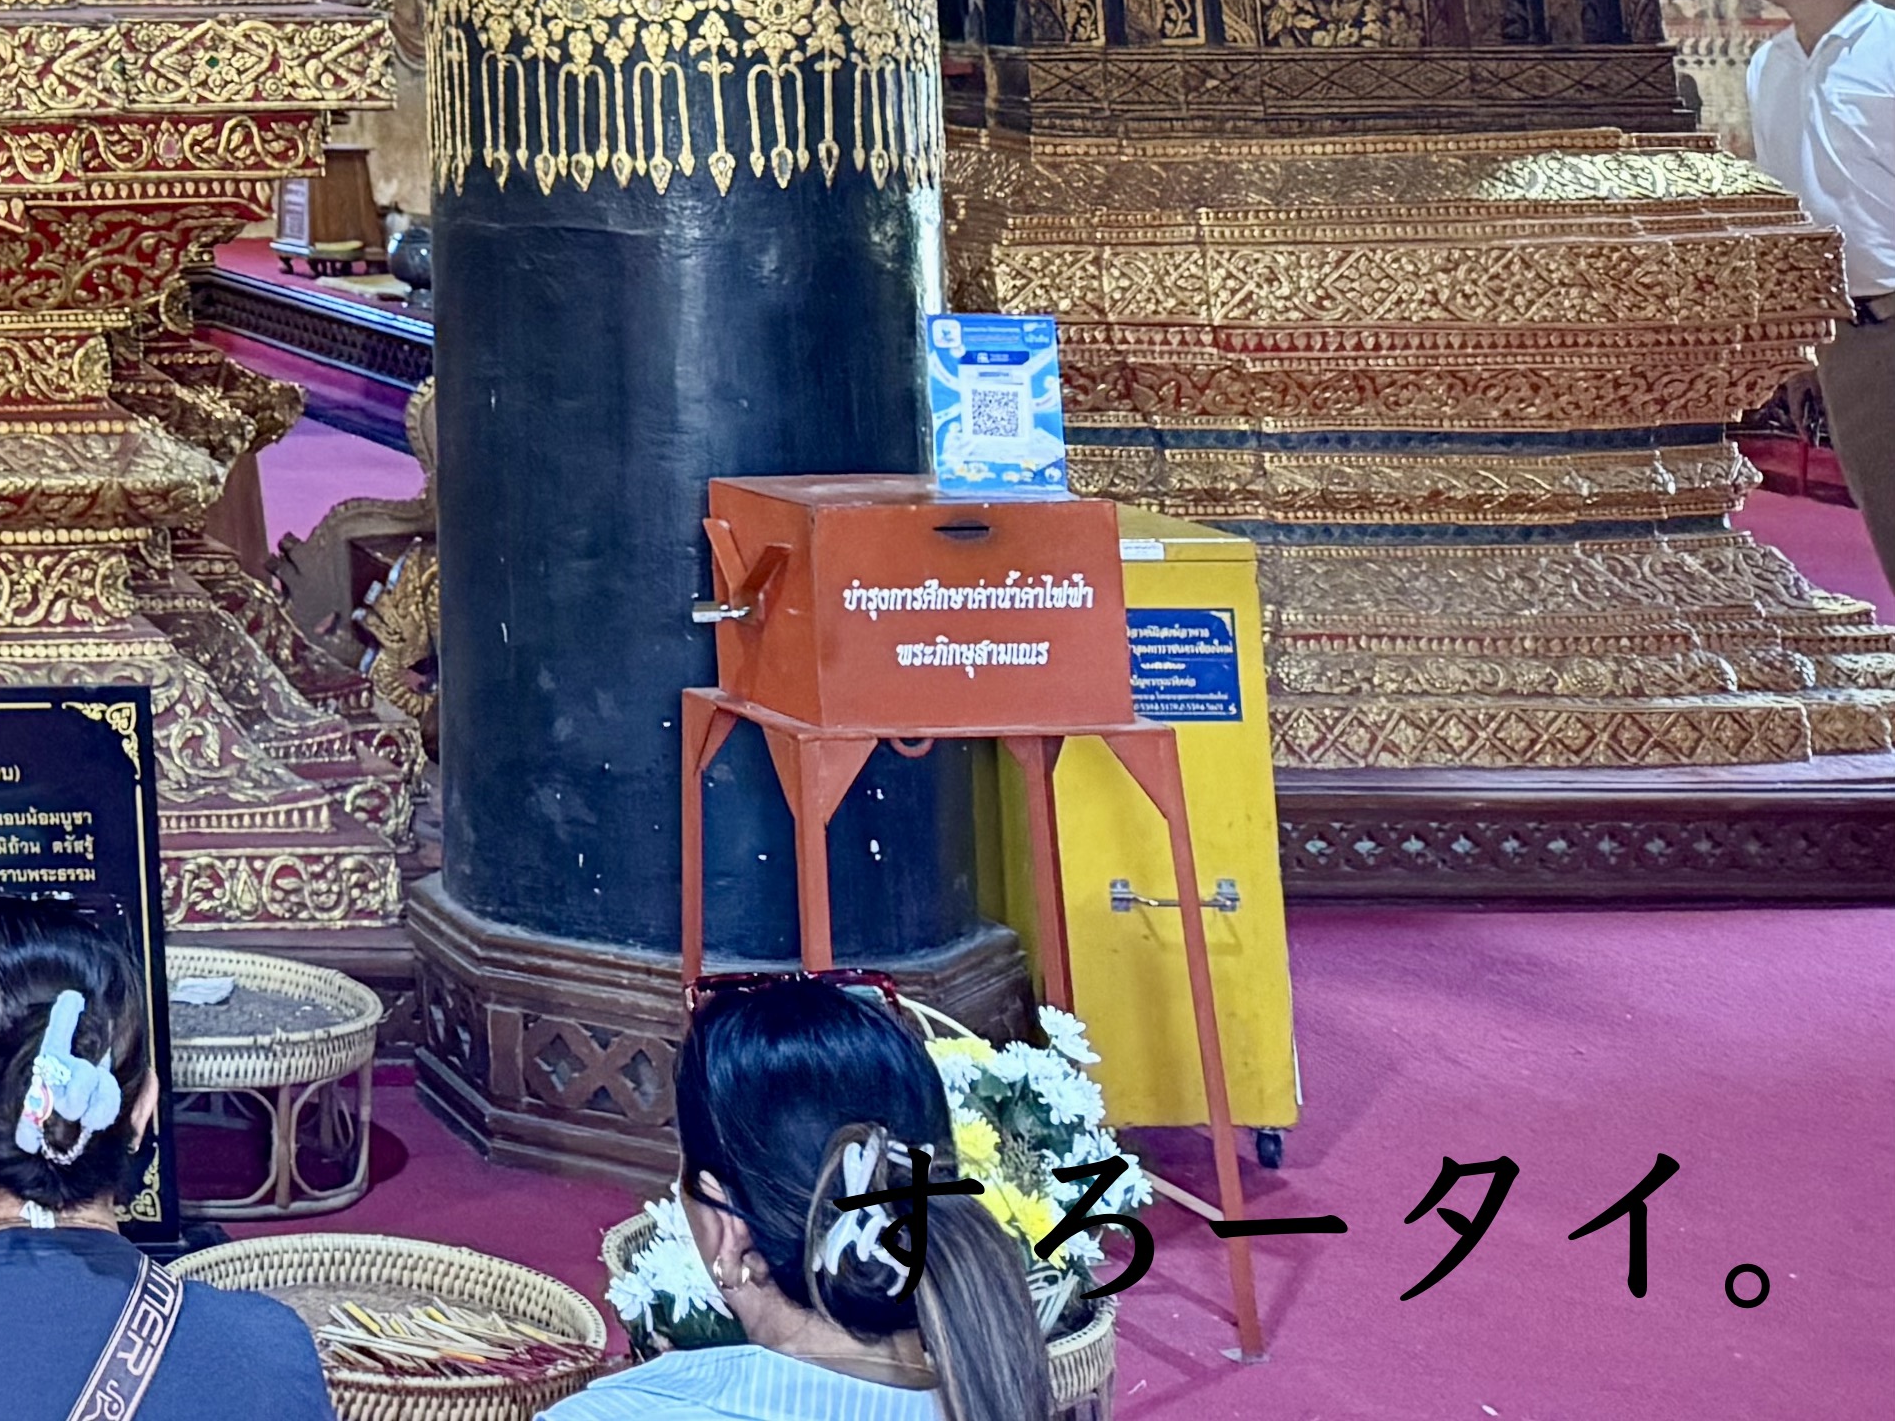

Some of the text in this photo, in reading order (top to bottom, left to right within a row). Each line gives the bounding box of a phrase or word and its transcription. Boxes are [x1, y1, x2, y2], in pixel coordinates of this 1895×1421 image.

[843, 570, 1093, 620] บำรุงการศึกษาค่าน้ำค่าไฟฟ้า
[895, 637, 1049, 678] พระภิกษุสามเณร
[51, 833, 94, 862] ตรัสรู้
